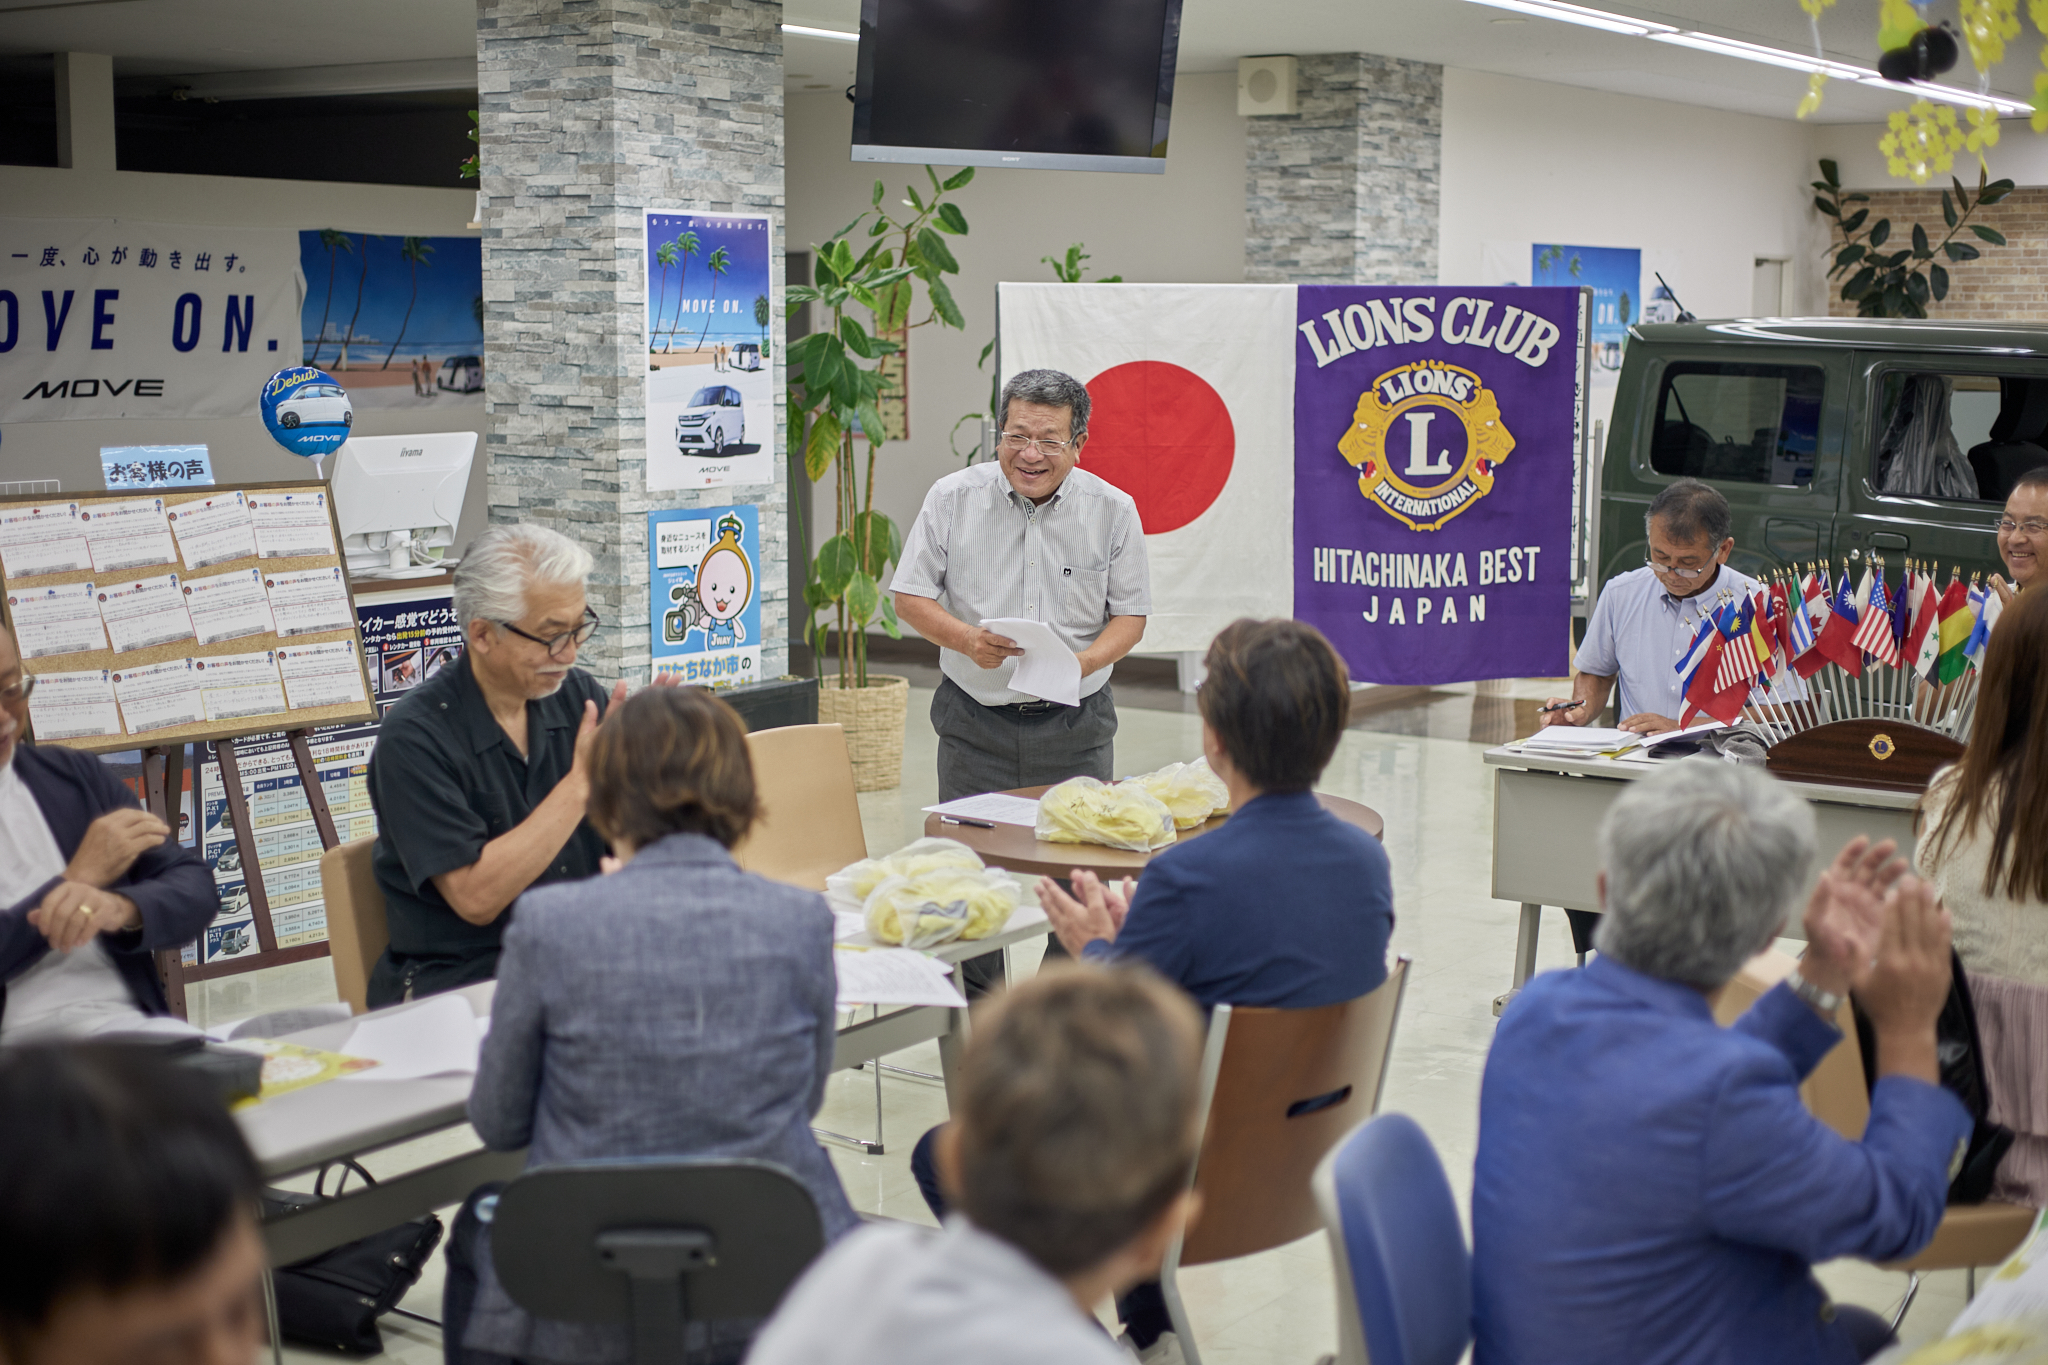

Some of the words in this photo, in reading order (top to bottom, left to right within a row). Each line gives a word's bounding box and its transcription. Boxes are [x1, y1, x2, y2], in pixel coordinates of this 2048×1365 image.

[682, 299, 715, 314] MOVE
[723, 300, 743, 314] ON.
[172, 292, 278, 353] ON.
[1298, 296, 1436, 369] LIONS
[1441, 296, 1560, 368] CLUB
[22, 379, 164, 400] MOVE
[272, 369, 319, 396] Debut!
[1380, 368, 1474, 404] LIONS
[298, 434, 342, 443] MOVE
[1404, 412, 1452, 476] L
[400, 447, 423, 458] iiyama
[108, 459, 204, 483] お客様の声
[699, 465, 730, 474] MOVE
[1374, 480, 1478, 517] INTERNATIONAL
[661, 532, 706, 543] 身近なニュースを
[661, 544, 705, 555] 取材するジェイ！
[1314, 547, 1468, 589] HITACHINAKA
[1479, 546, 1541, 586] BEST
[1362, 594, 1486, 625] JAPAN
[711, 633, 732, 646] JWAY
